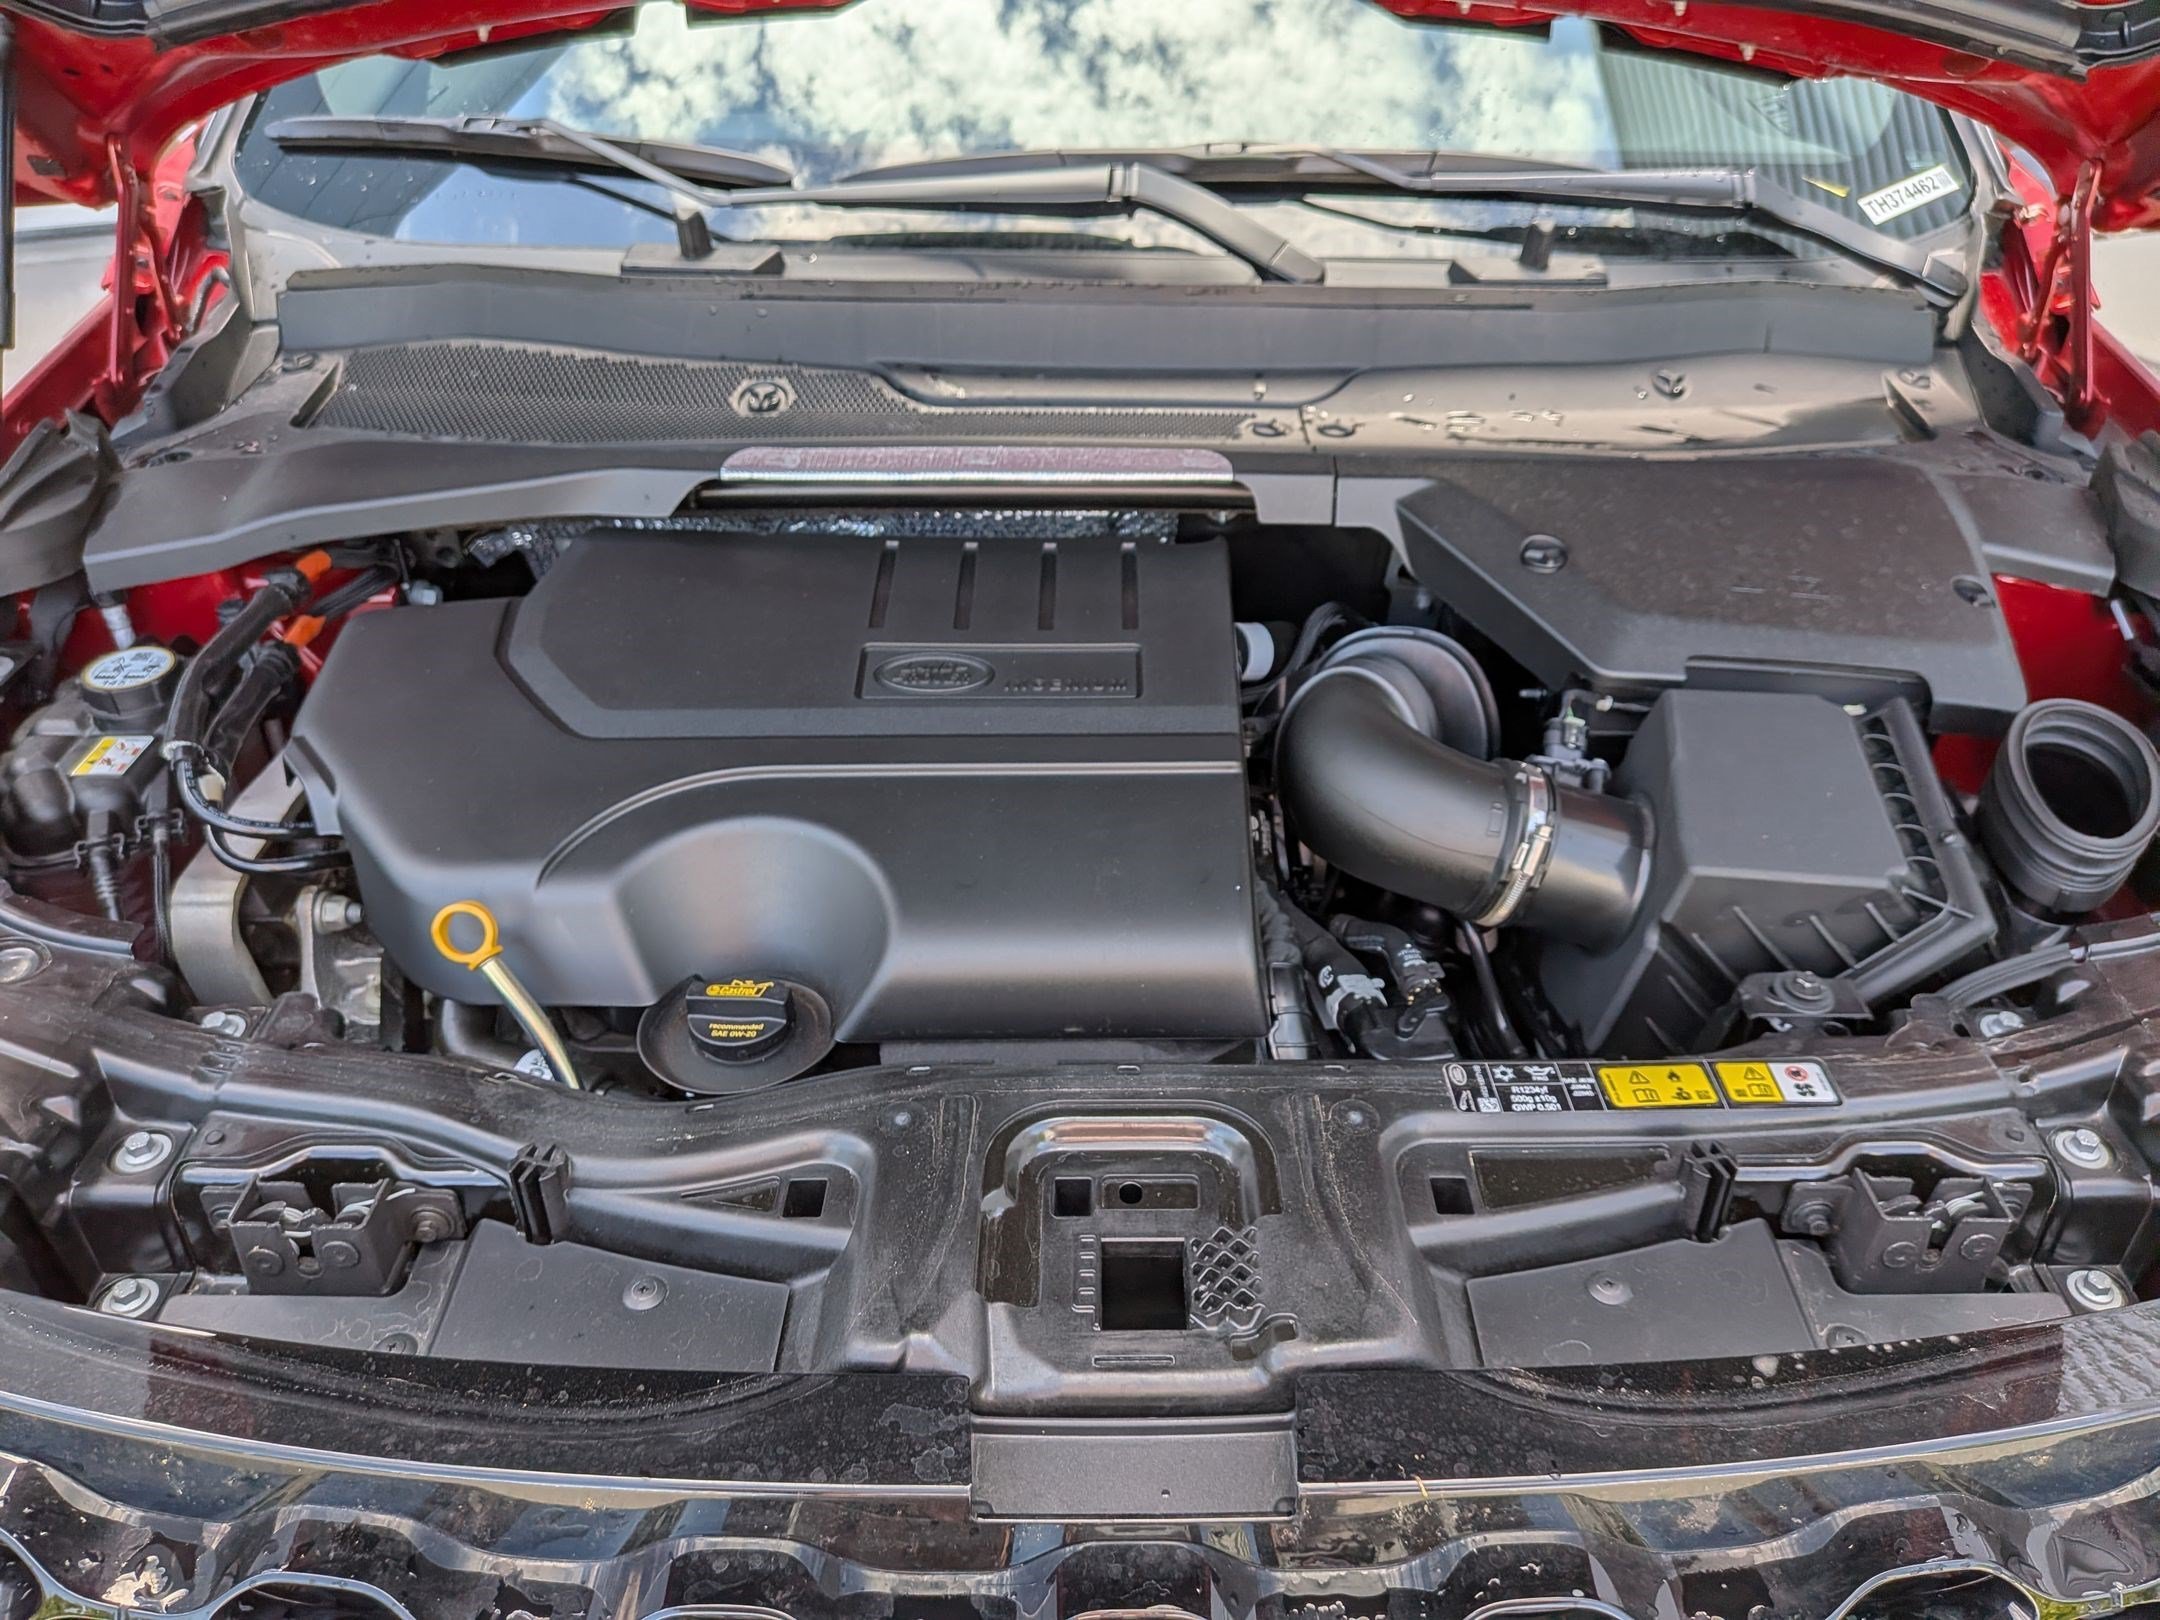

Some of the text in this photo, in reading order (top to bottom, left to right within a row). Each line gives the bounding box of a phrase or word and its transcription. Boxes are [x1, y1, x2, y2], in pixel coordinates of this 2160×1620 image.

[1863, 175, 1940, 217] TH374462
[719, 986, 757, 996] Castrol
[709, 1023, 765, 1031] recommended
[711, 1030, 757, 1038] SAE 0W-20
[1510, 1085, 1549, 1095] R1234yf
[1511, 1103, 1536, 1112] GWP
